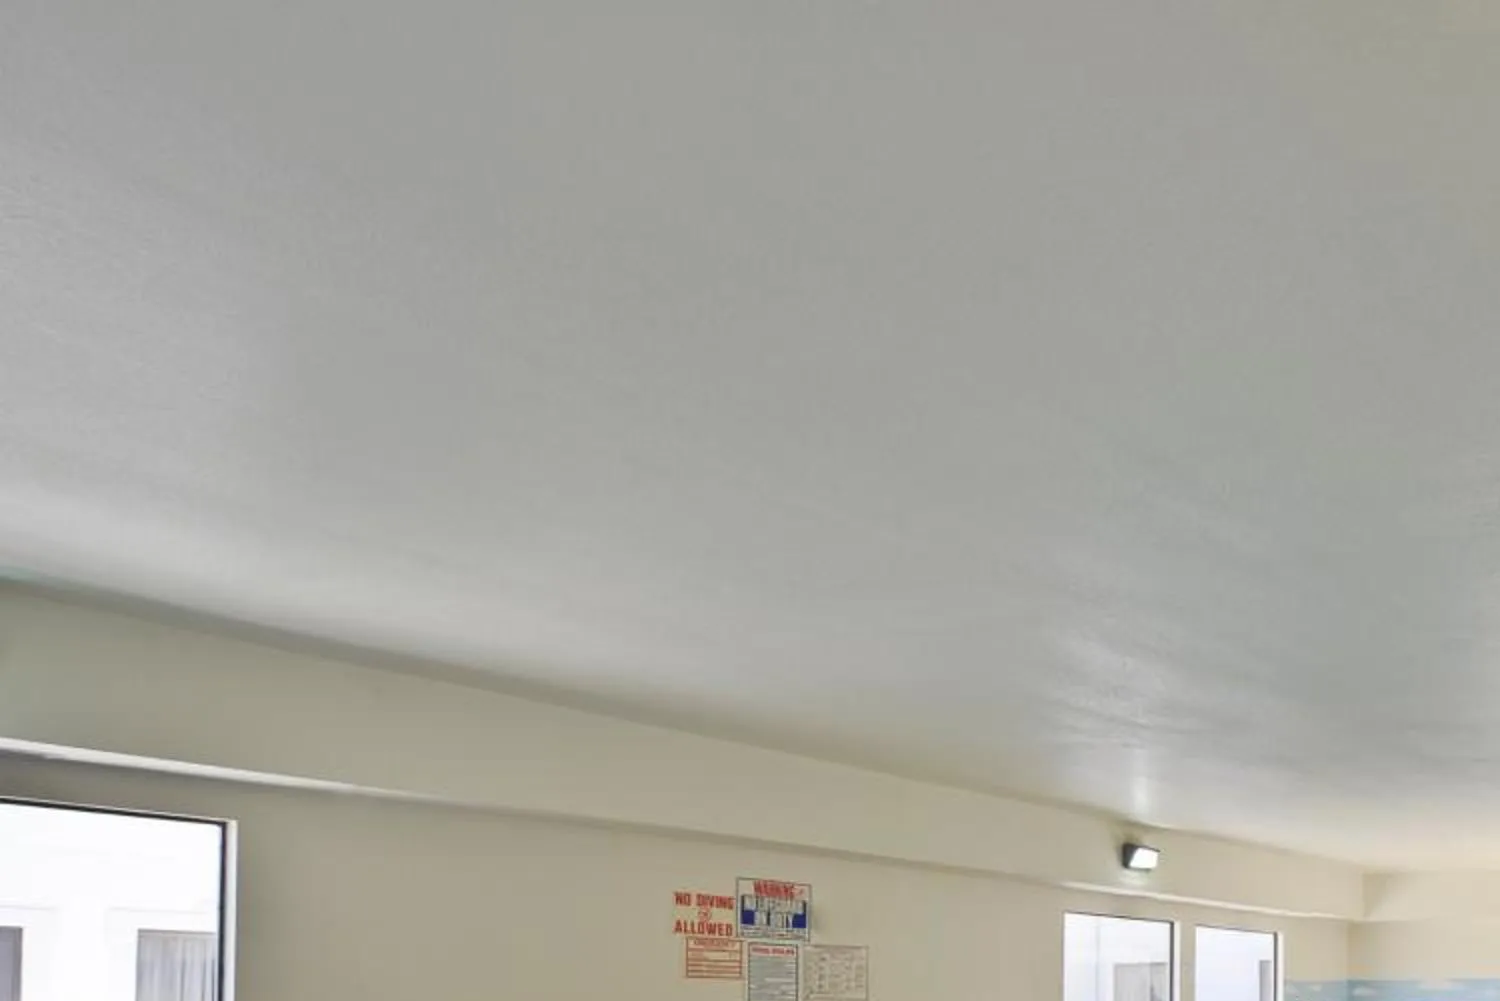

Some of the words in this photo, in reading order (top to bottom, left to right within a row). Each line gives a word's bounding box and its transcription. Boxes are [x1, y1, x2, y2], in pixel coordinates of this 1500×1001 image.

[674, 892, 691, 907] NO
[696, 893, 734, 911] DIVING
[674, 919, 733, 937] ALLOWED
